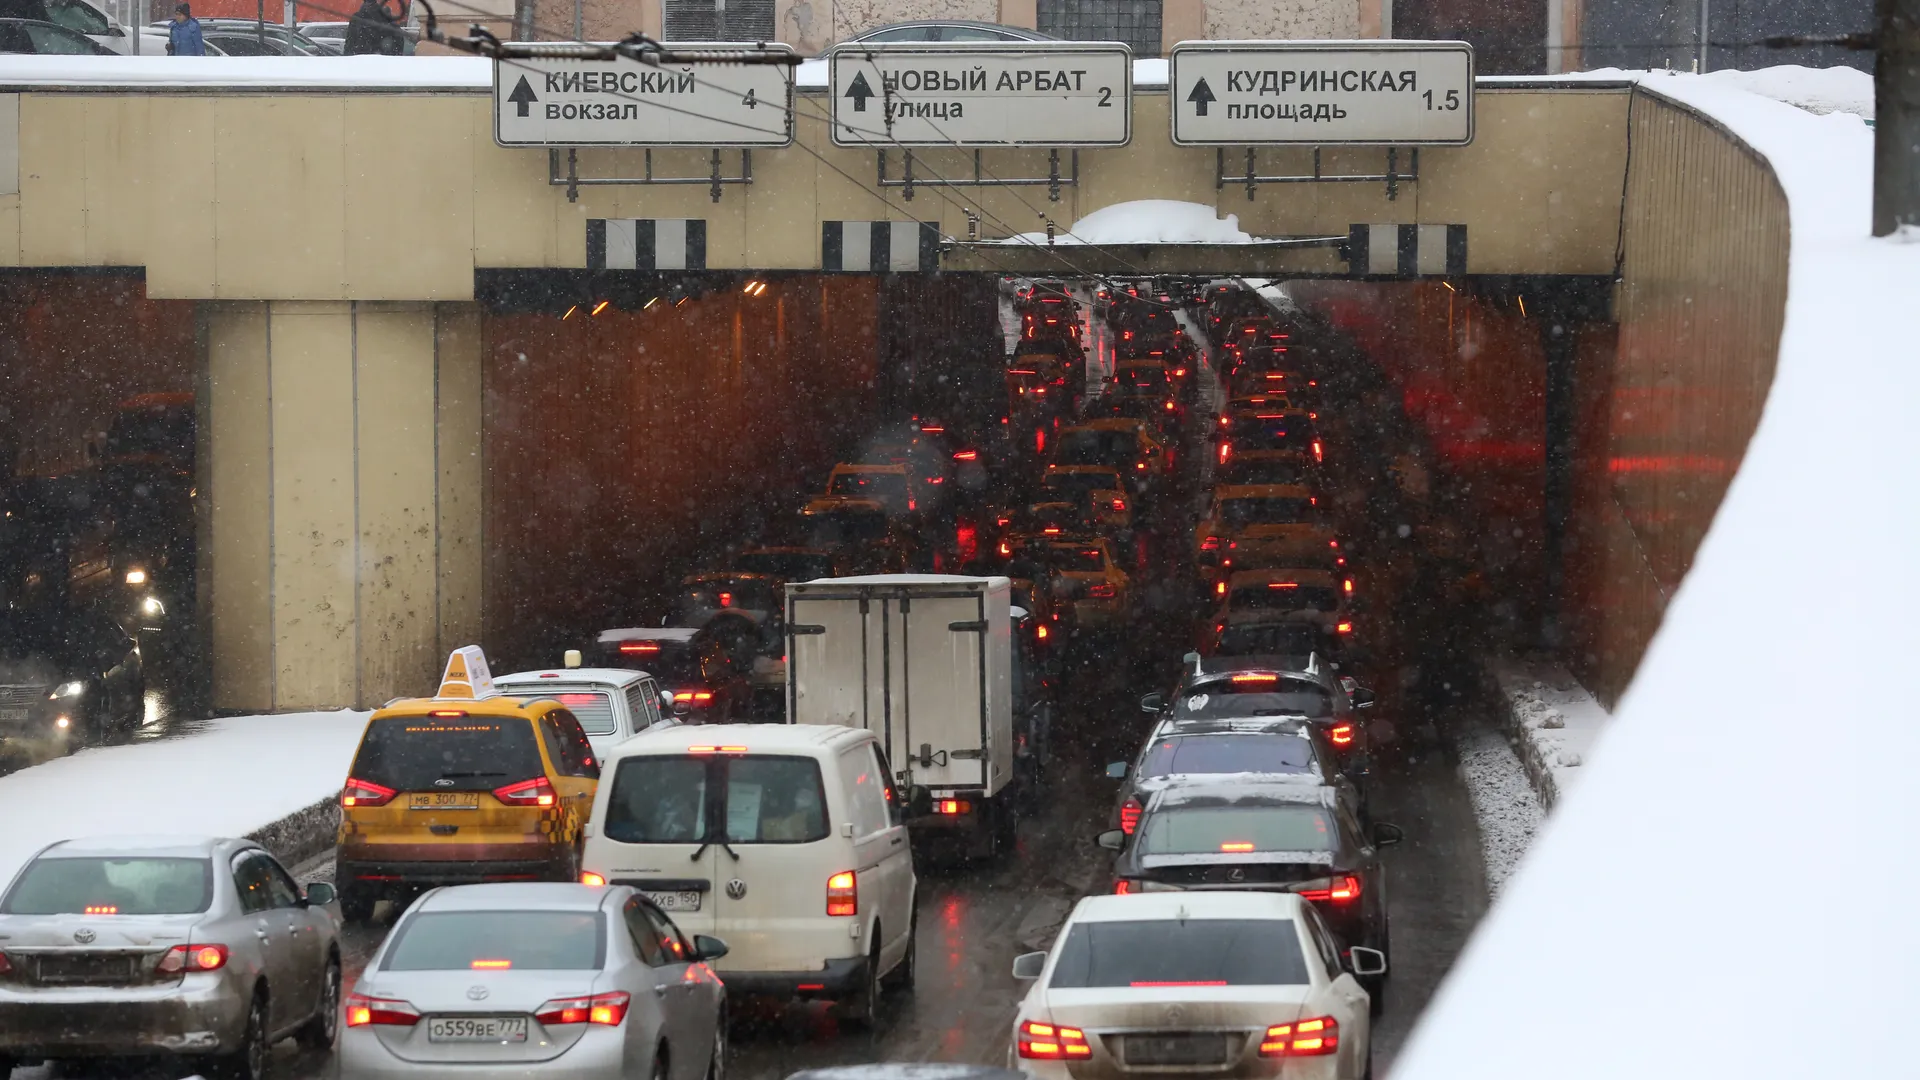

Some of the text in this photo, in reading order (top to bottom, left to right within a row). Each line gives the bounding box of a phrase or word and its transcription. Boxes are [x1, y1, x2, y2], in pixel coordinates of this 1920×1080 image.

[545, 67, 695, 93] КИЕВСКИЙ
[882, 66, 1087, 91] НОВЫЙ АРБАТ
[1226, 70, 1417, 96] КУДРИНСКАЯ
[741, 88, 757, 110] 4
[1097, 86, 1112, 107] 2
[1421, 89, 1460, 111] 1.5
[545, 103, 638, 120] вокзал
[884, 102, 964, 121] улица
[1227, 103, 1348, 122] площадь
[435, 793, 457, 805] 300
[678, 892, 697, 904] 150
[498, 1019, 521, 1032] 777
